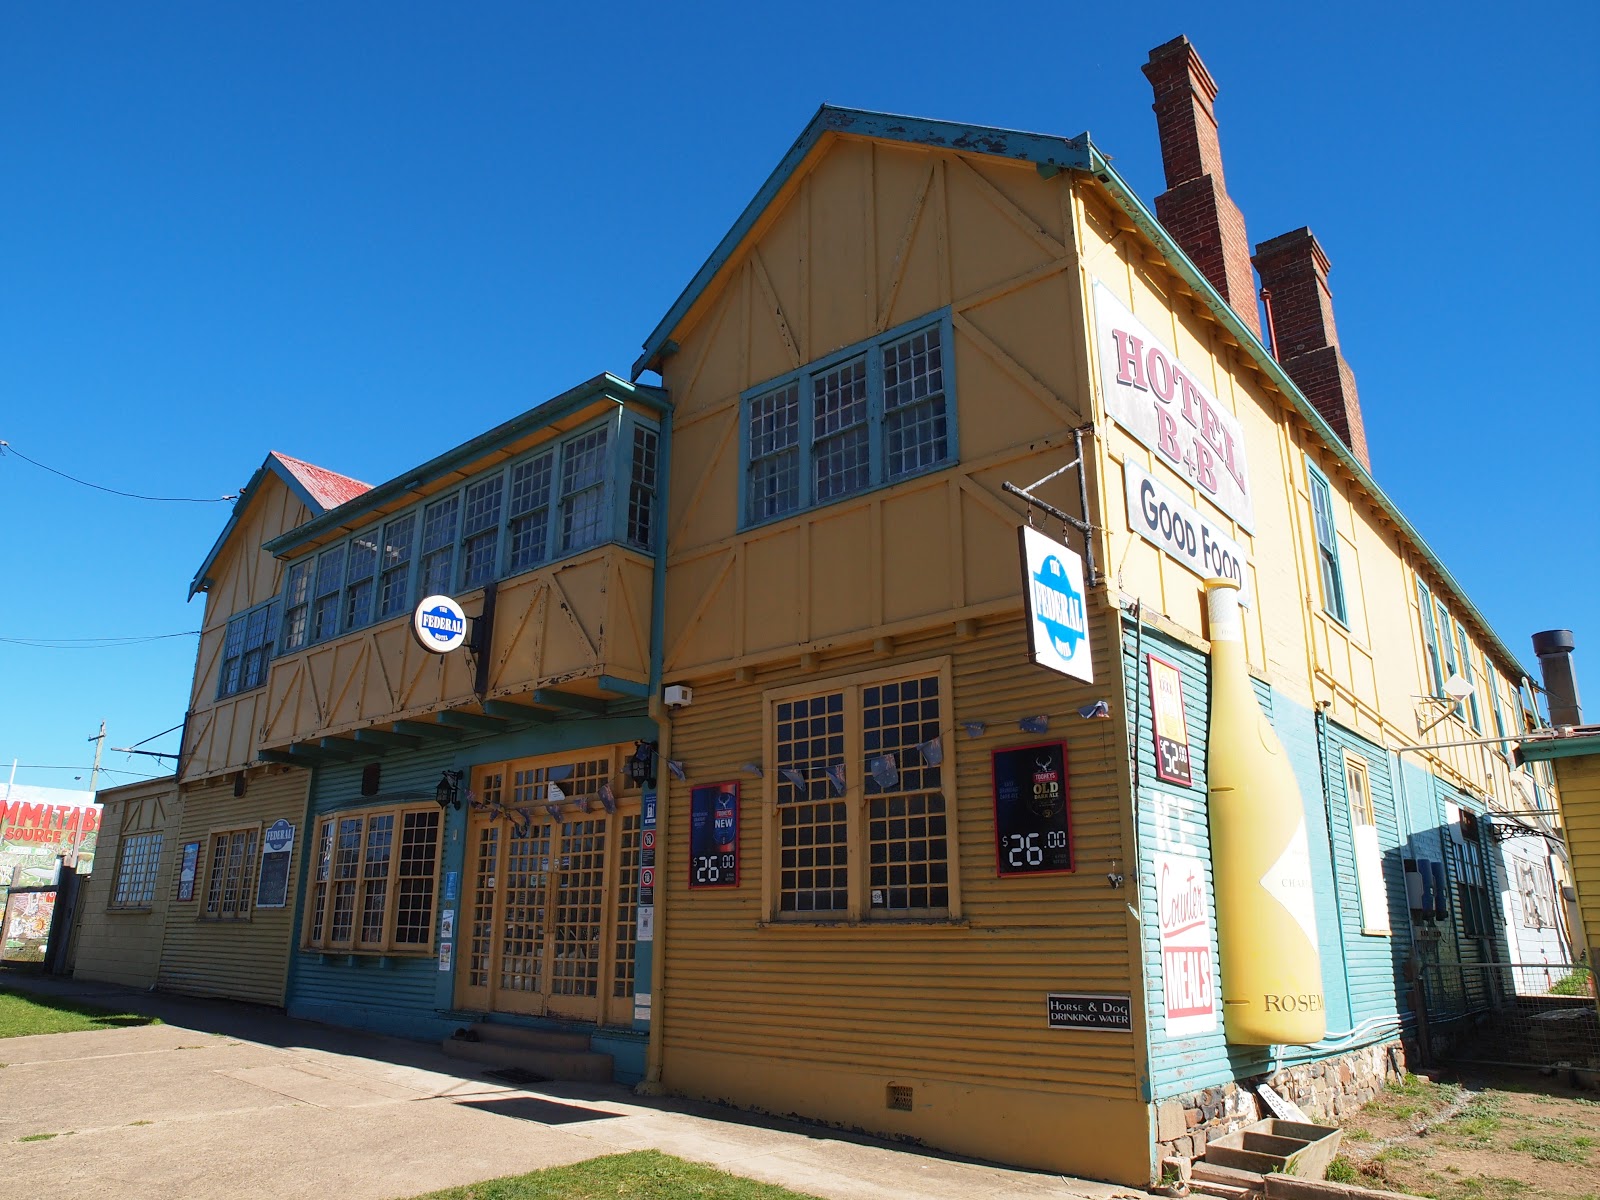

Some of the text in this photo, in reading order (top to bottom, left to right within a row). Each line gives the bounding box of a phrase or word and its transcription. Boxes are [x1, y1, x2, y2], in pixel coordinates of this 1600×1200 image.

[1112, 328, 1246, 496] HOTEL
[1034, 580, 1083, 633] FEDERAL
[423, 614, 461, 633] FEDERAL
[1033, 782, 1059, 795] OLD
[0, 800, 102, 831] MMITAB
[714, 818, 733, 828] NEW
[1153, 791, 1197, 856] ICE
[4, 827, 62, 843] SOURCE
[266, 828, 292, 842] FEDERAL
[1161, 862, 1204, 929] Counter
[1165, 950, 1211, 1010] MEALS
[1088, 1001, 1098, 1013] &
[1051, 1012, 1129, 1024] DRINKING WATER
